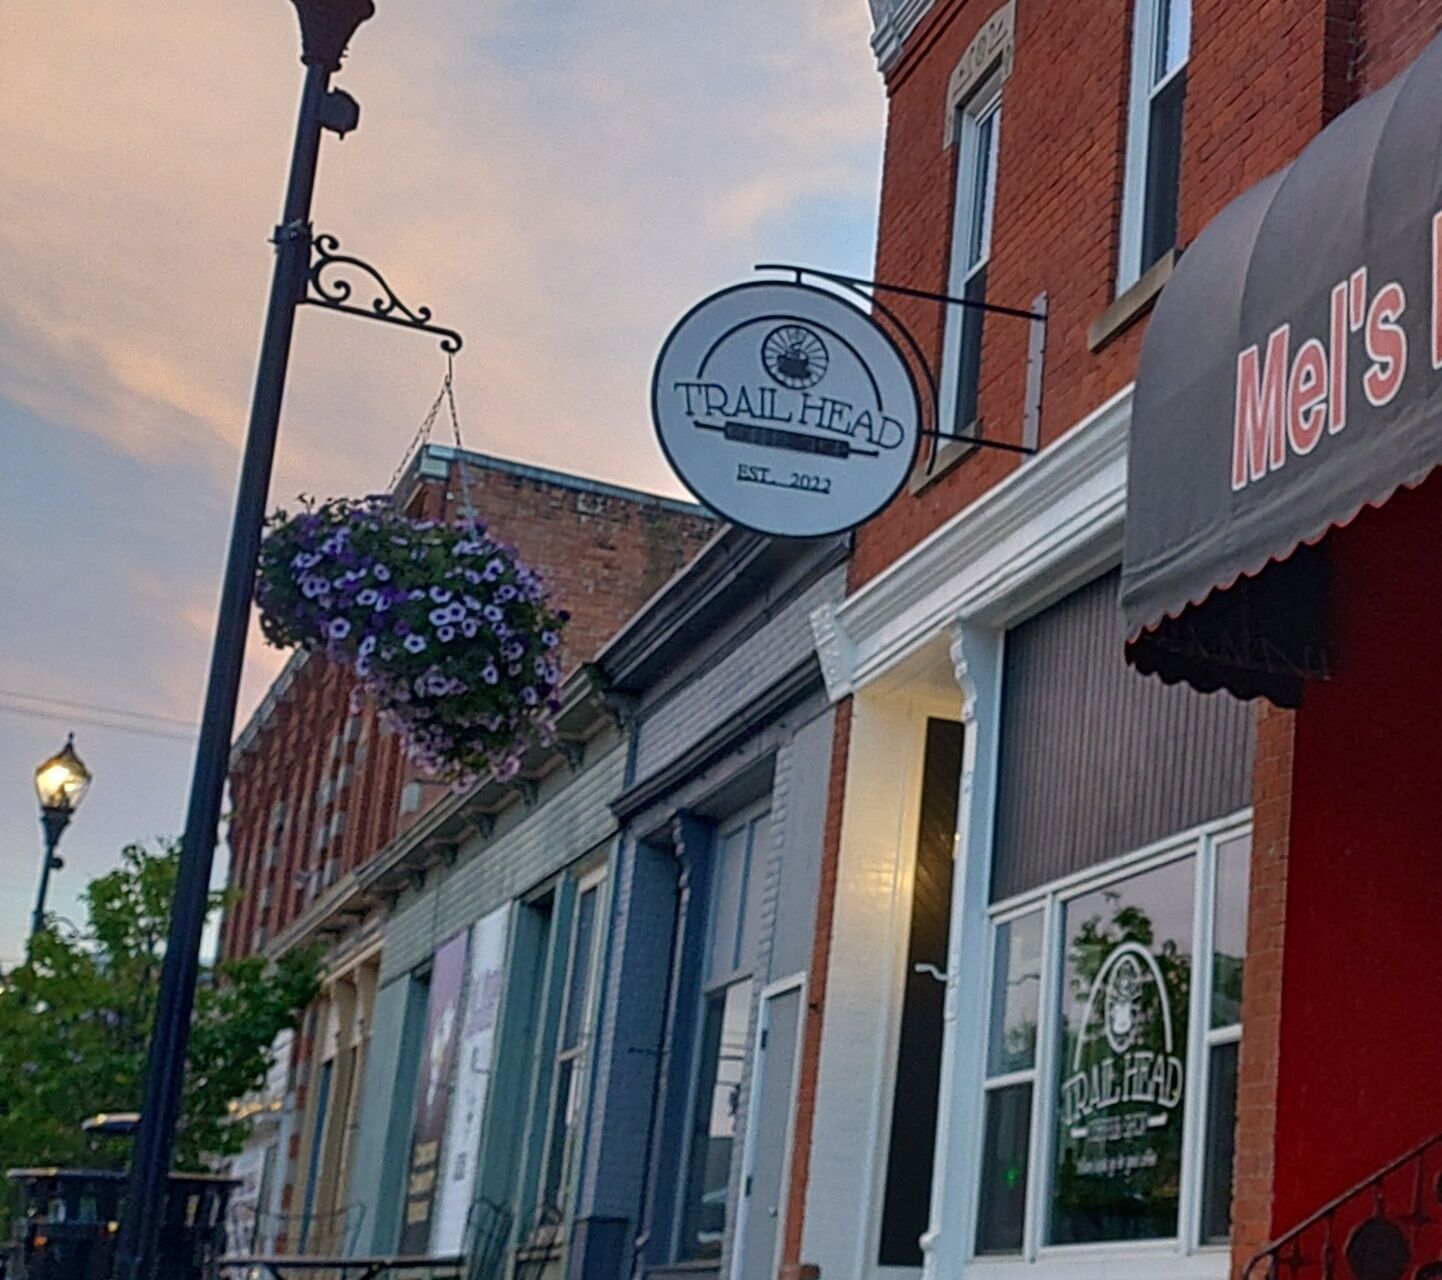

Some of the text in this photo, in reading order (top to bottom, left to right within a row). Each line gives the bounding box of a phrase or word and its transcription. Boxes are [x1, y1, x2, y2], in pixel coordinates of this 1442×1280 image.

[1232, 266, 1407, 491] Mel's
[673, 382, 905, 450] TRAIL HEAD
[737, 463, 832, 494] EST. 2022
[1061, 1051, 1184, 1126] TRAIL HEAD
